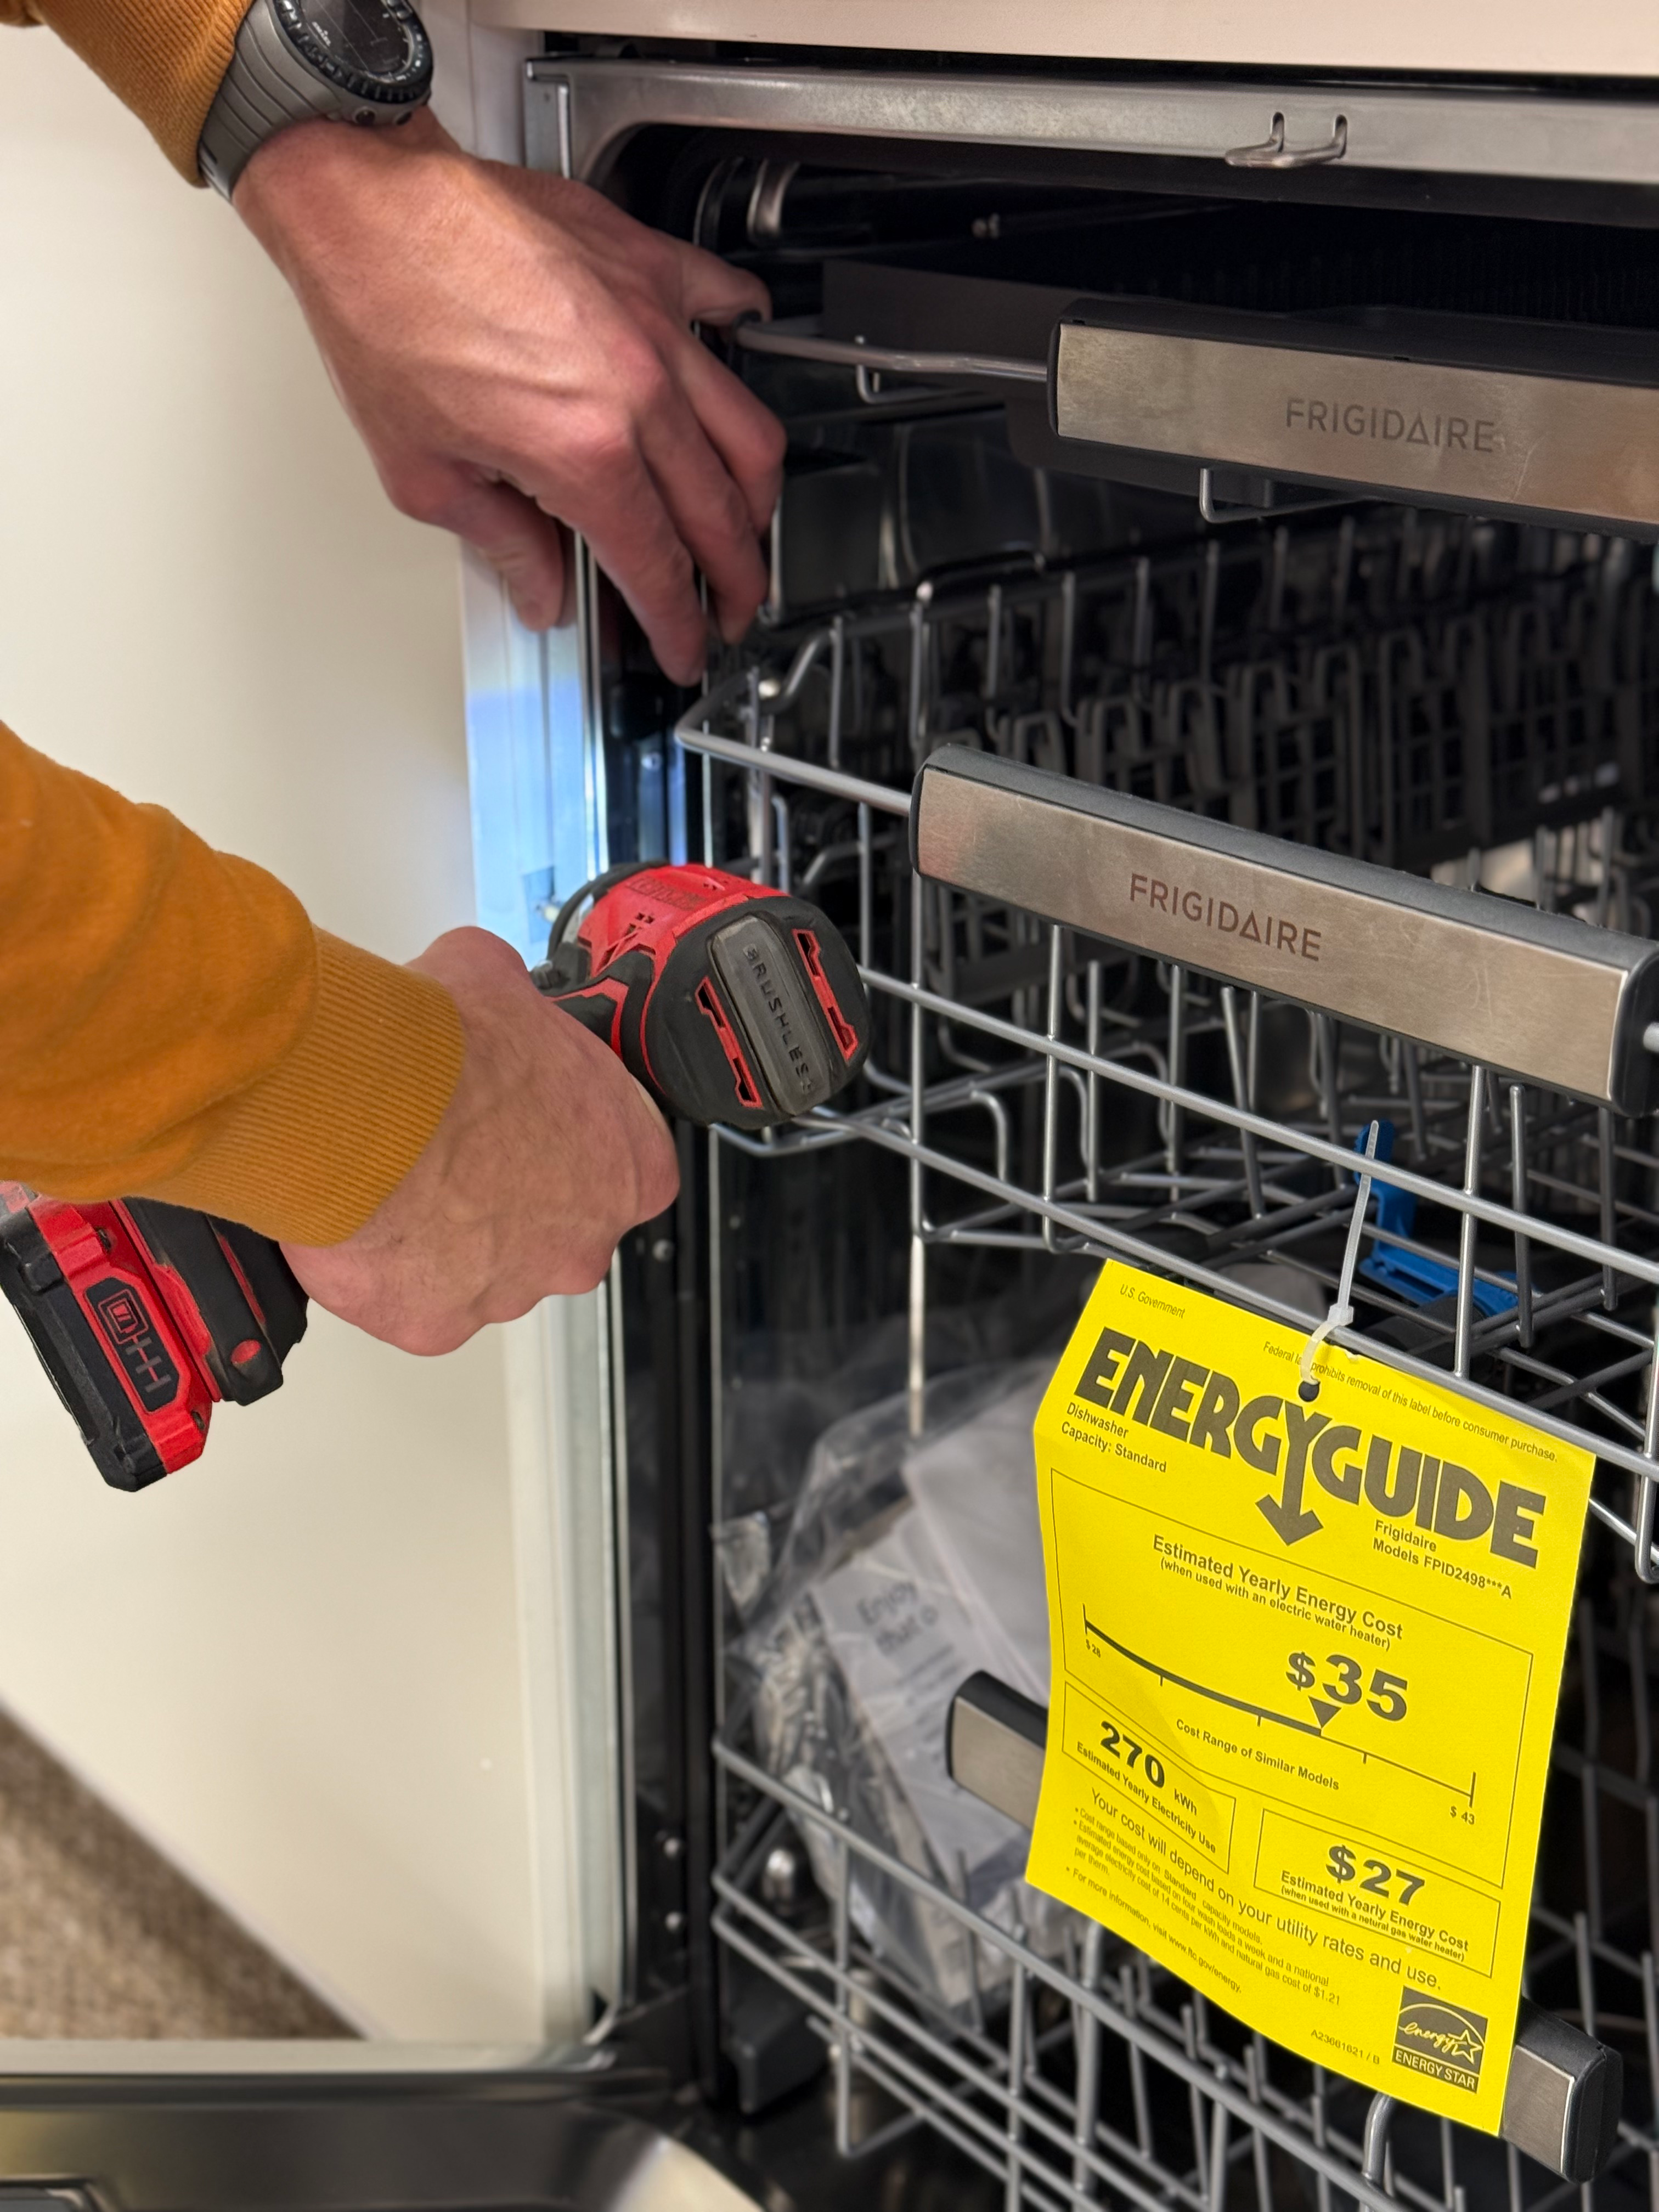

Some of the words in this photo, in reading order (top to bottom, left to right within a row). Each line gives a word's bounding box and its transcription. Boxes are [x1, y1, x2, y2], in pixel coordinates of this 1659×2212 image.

[1285, 398, 1495, 453] FRIGIDAIRE
[1130, 873, 1322, 962] FRIGIDAIRE
[1120, 1284, 1135, 1299] U.S.
[1138, 1290, 1186, 1319] Government
[1066, 1402, 1128, 1438] Dishwasher
[1263, 1341, 1295, 1361] Federal
[1310, 1362, 1345, 1383] prohibits
[1346, 1375, 1381, 1399] removal
[1381, 1389, 1392, 1399] of
[1392, 1391, 1408, 1407] this
[1409, 1398, 1431, 1415] label
[1432, 1407, 1460, 1426] before
[1463, 1420, 1510, 1444] consumer
[1510, 1438, 1558, 1463] purchase.
[1061, 1421, 1112, 1453] Capacity:
[1115, 1443, 1167, 1473] Standard
[1074, 1326, 1547, 1569] ENERGYGUIDE
[1373, 1537, 1419, 1565] Models
[1375, 1519, 1437, 1552] Frigidaire
[1153, 1533, 1234, 1578] Estimated
[1238, 1565, 1291, 1600] Yearly
[1296, 1585, 1357, 1624] Energy
[1362, 1611, 1403, 1640] Cost
[1160, 1556, 1192, 1579] (when
[1195, 1571, 1222, 1590] used
[1225, 1583, 1249, 1599] with
[1252, 1592, 1266, 1605] an
[1269, 1598, 1311, 1621] electric
[1314, 1613, 1347, 1633] water
[1350, 1624, 1390, 1652] heater)
[1285, 1650, 1408, 1722] $35
[1100, 1720, 1165, 1788] 270
[1174, 1788, 1197, 1816] kWh
[1176, 1719, 1200, 1739] Cost
[1203, 1730, 1238, 1754] Range
[1240, 1747, 1253, 1759] of
[1255, 1751, 1295, 1774] Similar
[1298, 1765, 1340, 1790] Models
[1077, 1741, 1120, 1781] Estimated
[1122, 1774, 1149, 1804] Yearly
[1152, 1796, 1197, 1839] Electricity
[1199, 1831, 1216, 1853] Use
[1074, 1847, 1086, 1860] per
[1087, 1851, 1110, 1876] therm.
[1080, 1808, 1094, 1825] Cost
[1096, 1820, 1115, 1839] range
[1116, 1833, 1136, 1855] based
[1137, 1850, 1151, 1867] only
[1152, 1861, 1160, 1874] on
[1164, 1869, 1197, 1901] Standard
[1203, 1899, 1231, 1927] capacity
[1232, 1921, 1262, 1945] models.
[1092, 1787, 1118, 1818] Your
[1121, 1814, 1145, 1841] cost
[1148, 1832, 1166, 1857] will
[1170, 1849, 1215, 1893] depend
[1218, 1887, 1234, 1908] on
[1238, 1899, 1272, 1925] your
[1277, 1917, 1318, 1946] utility
[1323, 1934, 1364, 1961] rates
[1370, 1953, 1402, 1974] and
[1407, 1965, 1441, 1990] use.
[1325, 1844, 1425, 1906] $27
[1073, 1867, 1087, 1883] For
[1087, 1877, 1107, 1897] more
[1108, 1889, 1151, 1928] information,
[1153, 1922, 1167, 1940] visit
[1076, 1835, 1104, 1858] average
[1105, 1853, 1136, 1882] electricity
[1137, 1876, 1151, 1893] cost
[1152, 1887, 1159, 1898] of
[1162, 1893, 1170, 1906] 14
[1171, 1901, 1189, 1921] cents
[1190, 1915, 1202, 1929] per
[1204, 1925, 1220, 1944] kWh
[1221, 1938, 1234, 1954] and
[1236, 1949, 1262, 1971] natural
[1265, 1966, 1280, 1980] gas
[1282, 1974, 1300, 1990] cost
[1303, 1983, 1312, 1994] of
[1313, 1986, 1340, 2006] $1.21
[1079, 1820, 1111, 1850] Estimated
[1113, 1844, 1135, 1869] energy
[1136, 1861, 1149, 1878] cost
[1151, 1871, 1171, 1894] based
[1172, 1889, 1181, 1902] on
[1182, 1895, 1196, 1913] four
[1197, 1907, 1216, 1928] wash
[1217, 1921, 1235, 1942] loads
[1237, 1937, 1243, 1947] a
[1244, 1940, 1266, 1960] week
[1267, 1954, 1284, 1968] and
[1286, 1962, 1291, 1972] a
[1294, 1966, 1329, 1987] national
[1281, 1870, 1344, 1902] Estimated
[1347, 1893, 1386, 1920] Yearly
[1390, 1910, 1435, 1939] Energy
[1439, 1929, 1469, 1952] Cost
[1281, 1884, 1307, 1901] (when
[1309, 1896, 1329, 1910] used
[1331, 1904, 1349, 1917] with
[1351, 1911, 1357, 1920] a
[1359, 1914, 1389, 1931] natural
[1391, 1927, 1406, 1938] gas
[1408, 1932, 1433, 1948] water
[1435, 1941, 1465, 1962] heater)
[1395, 2049, 1443, 2077] ENERGY
[1444, 2069, 1476, 2090] STAR
[1399, 2022, 1457, 2053] energy
